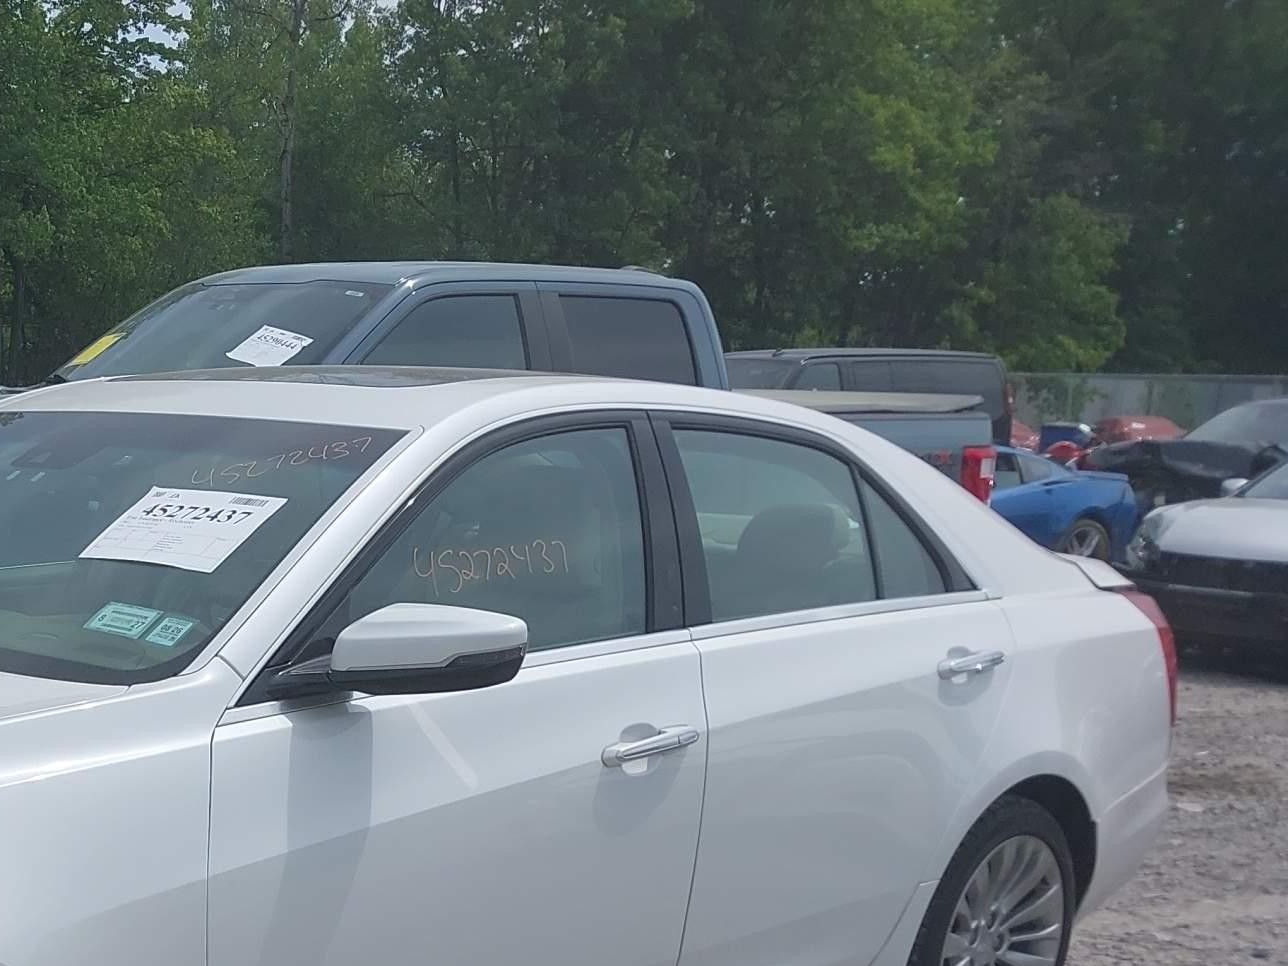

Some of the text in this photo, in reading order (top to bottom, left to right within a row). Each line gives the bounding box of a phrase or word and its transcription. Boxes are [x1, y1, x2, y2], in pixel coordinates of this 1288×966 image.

[191, 436, 372, 487] 45272437
[142, 503, 254, 525] 45272437
[413, 539, 569, 597] 45272437
